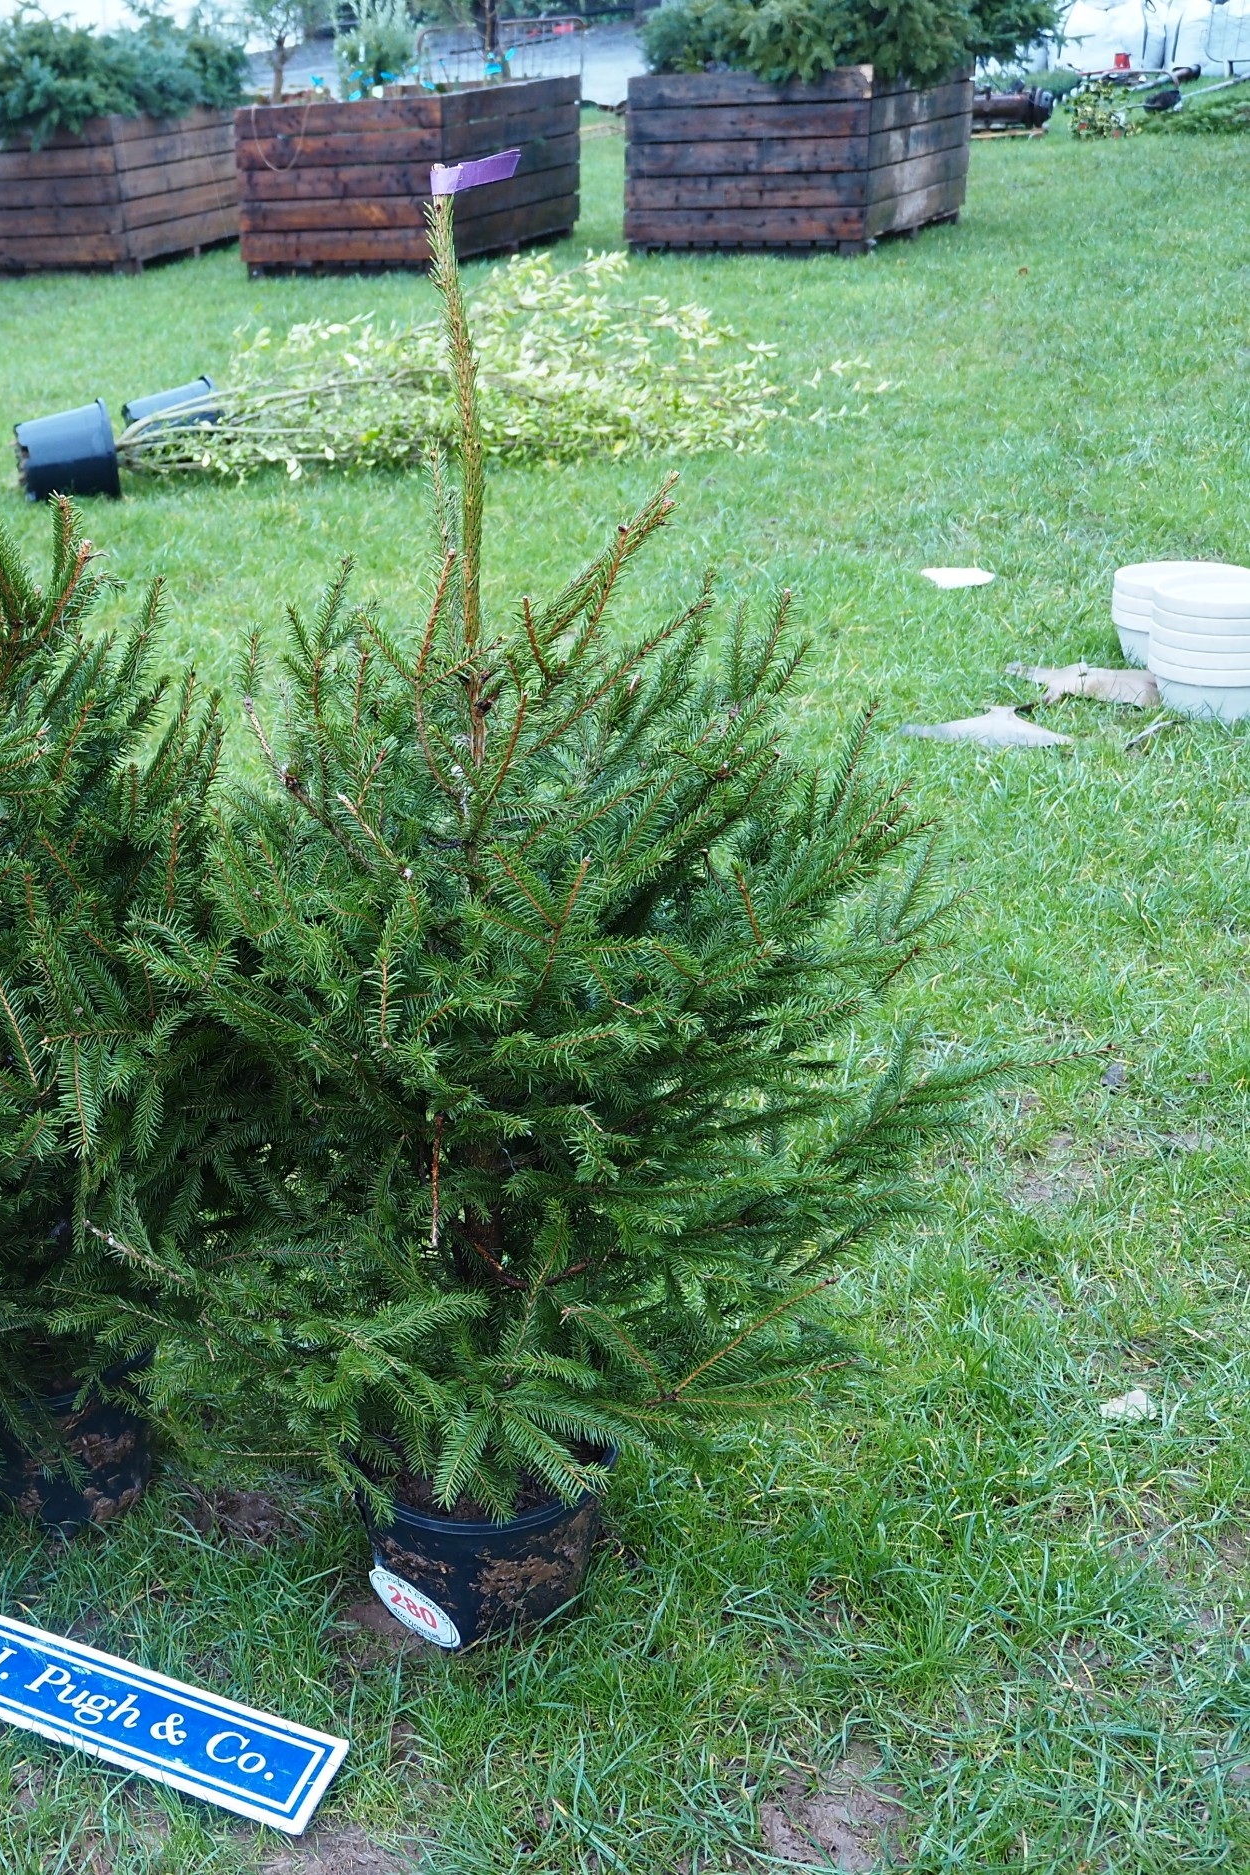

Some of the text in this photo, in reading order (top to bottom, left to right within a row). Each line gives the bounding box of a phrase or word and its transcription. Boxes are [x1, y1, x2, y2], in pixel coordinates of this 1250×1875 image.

[387, 1584, 437, 1629] 280
[23, 1663, 141, 1725] Pugh
[149, 1712, 188, 1746] &
[205, 1730, 274, 1781] Co.
